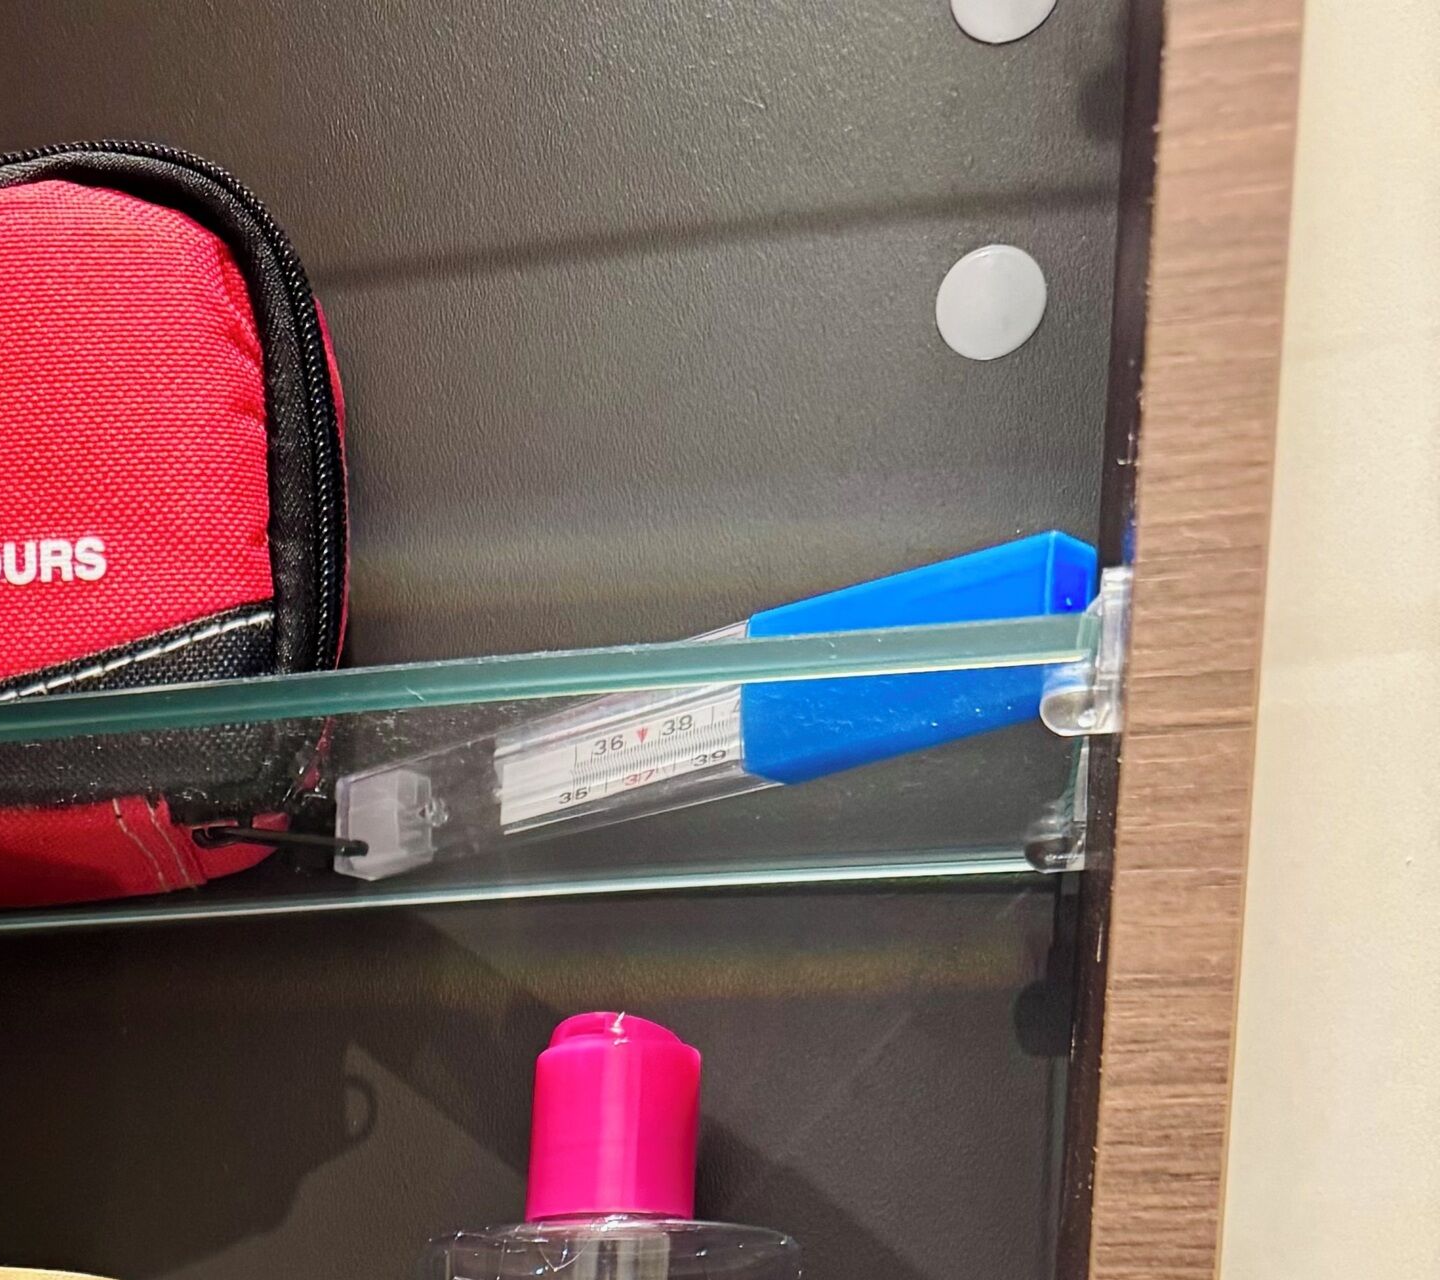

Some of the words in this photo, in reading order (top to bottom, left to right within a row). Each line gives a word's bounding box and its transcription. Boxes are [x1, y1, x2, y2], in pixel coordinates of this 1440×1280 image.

[594, 734, 624, 756] 36
[662, 714, 693, 736] 38
[559, 787, 587, 804] 35
[625, 769, 656, 786] 37
[693, 750, 727, 766] 39
